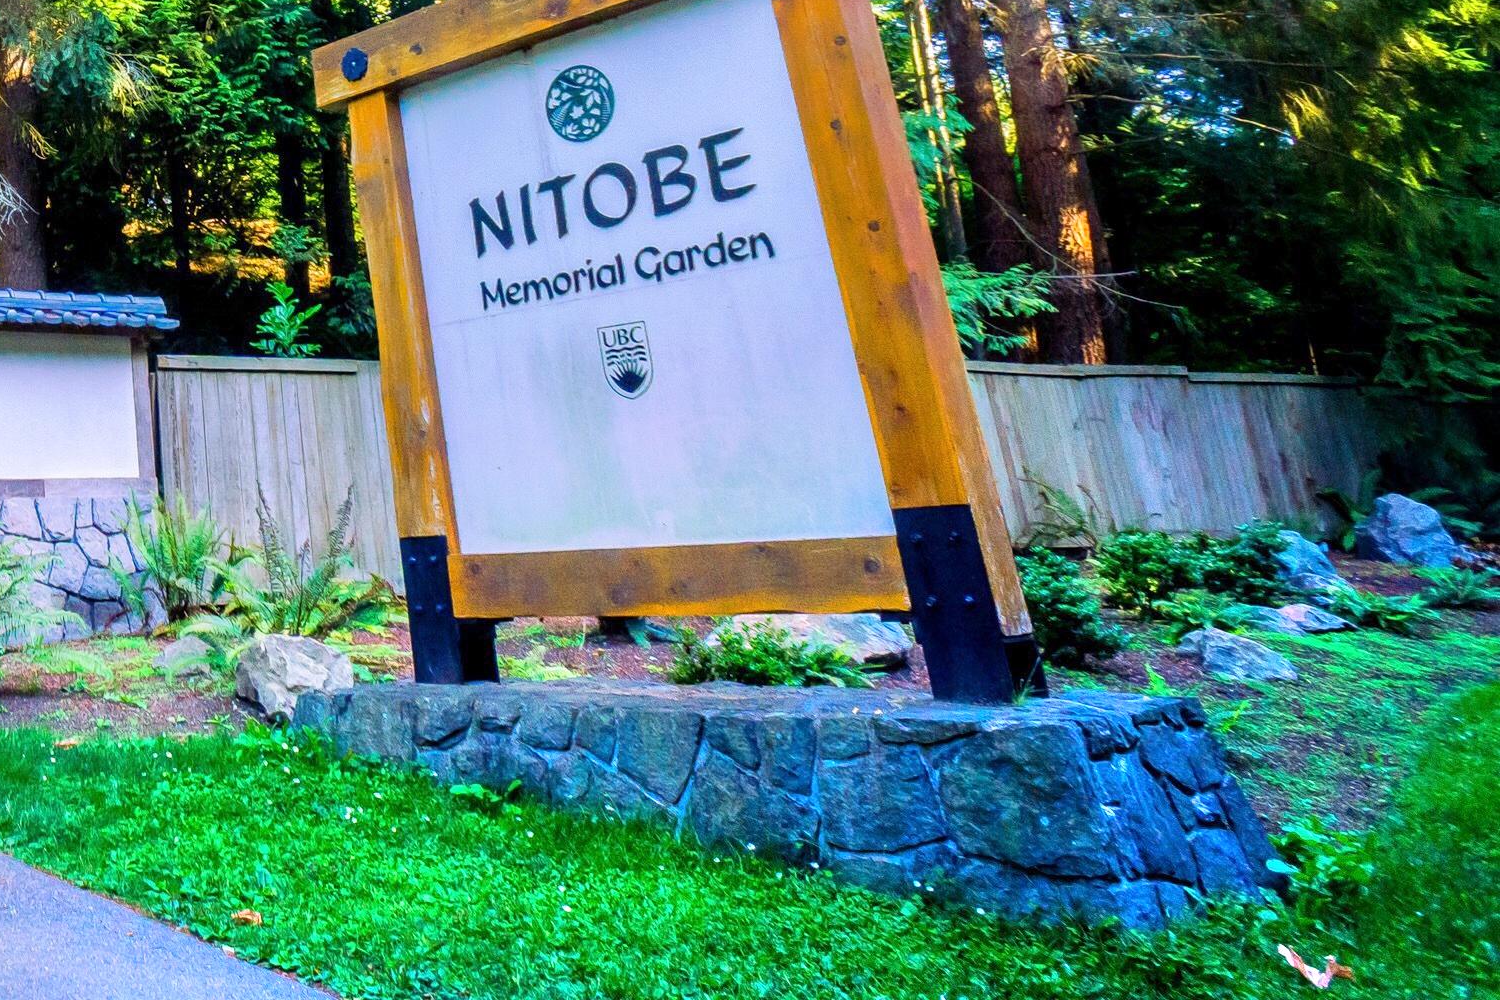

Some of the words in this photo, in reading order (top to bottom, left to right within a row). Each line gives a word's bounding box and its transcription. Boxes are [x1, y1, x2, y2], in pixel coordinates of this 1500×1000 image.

[469, 126, 757, 259] NITOBE
[479, 253, 626, 311] Memorial
[634, 231, 776, 283] Garden
[601, 325, 644, 348] UBC
